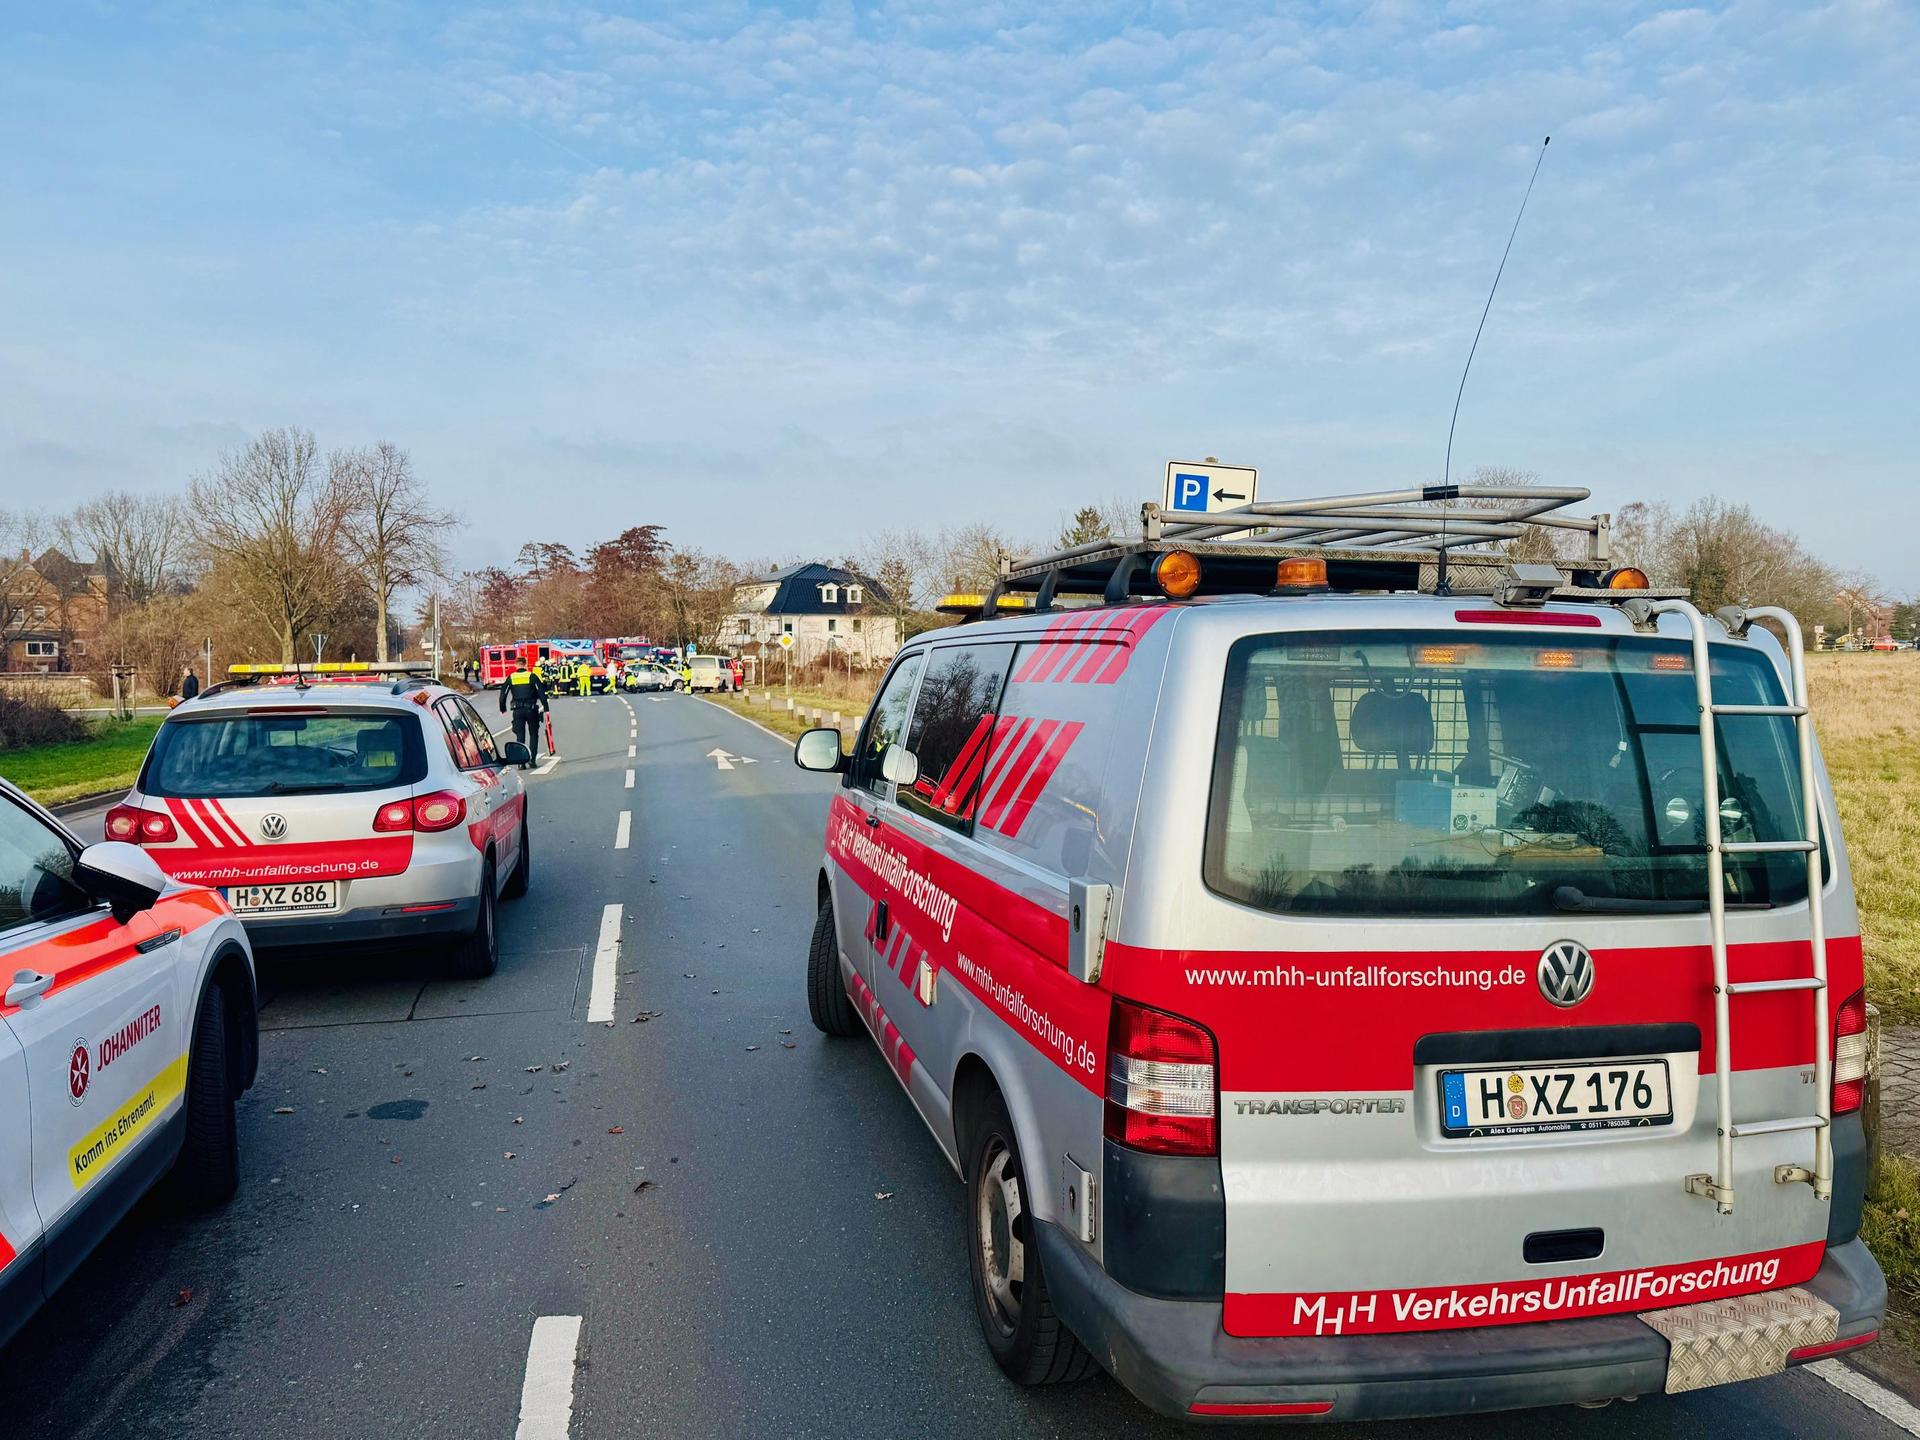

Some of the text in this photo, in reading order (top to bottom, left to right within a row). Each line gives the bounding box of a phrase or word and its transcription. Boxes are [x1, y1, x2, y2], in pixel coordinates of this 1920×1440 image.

[1182, 479, 1201, 506] P
[172, 859, 379, 880] www.mhh-unfallforschung.de
[236, 885, 327, 907] H XZ 686
[1184, 964, 1526, 992] www.mhh-unfallforschung.de
[957, 951, 1096, 1074] www.mhh-unfallforschung.de
[97, 1004, 161, 1072] JOHANNITER
[1233, 1098, 1406, 1115] TRANSPORTER
[1452, 1070, 1652, 1119] D H XZ 176
[75, 1090, 156, 1175] Komm ins Ehrenamt!
[1490, 1127, 1505, 1135] Alex
[1506, 1126, 1535, 1135] Garagen
[1538, 1123, 1571, 1132] Automobile
[1588, 1121, 1602, 1129] 0511
[1293, 1256, 1780, 1335] MHH VerkehrsUnfallForschung
